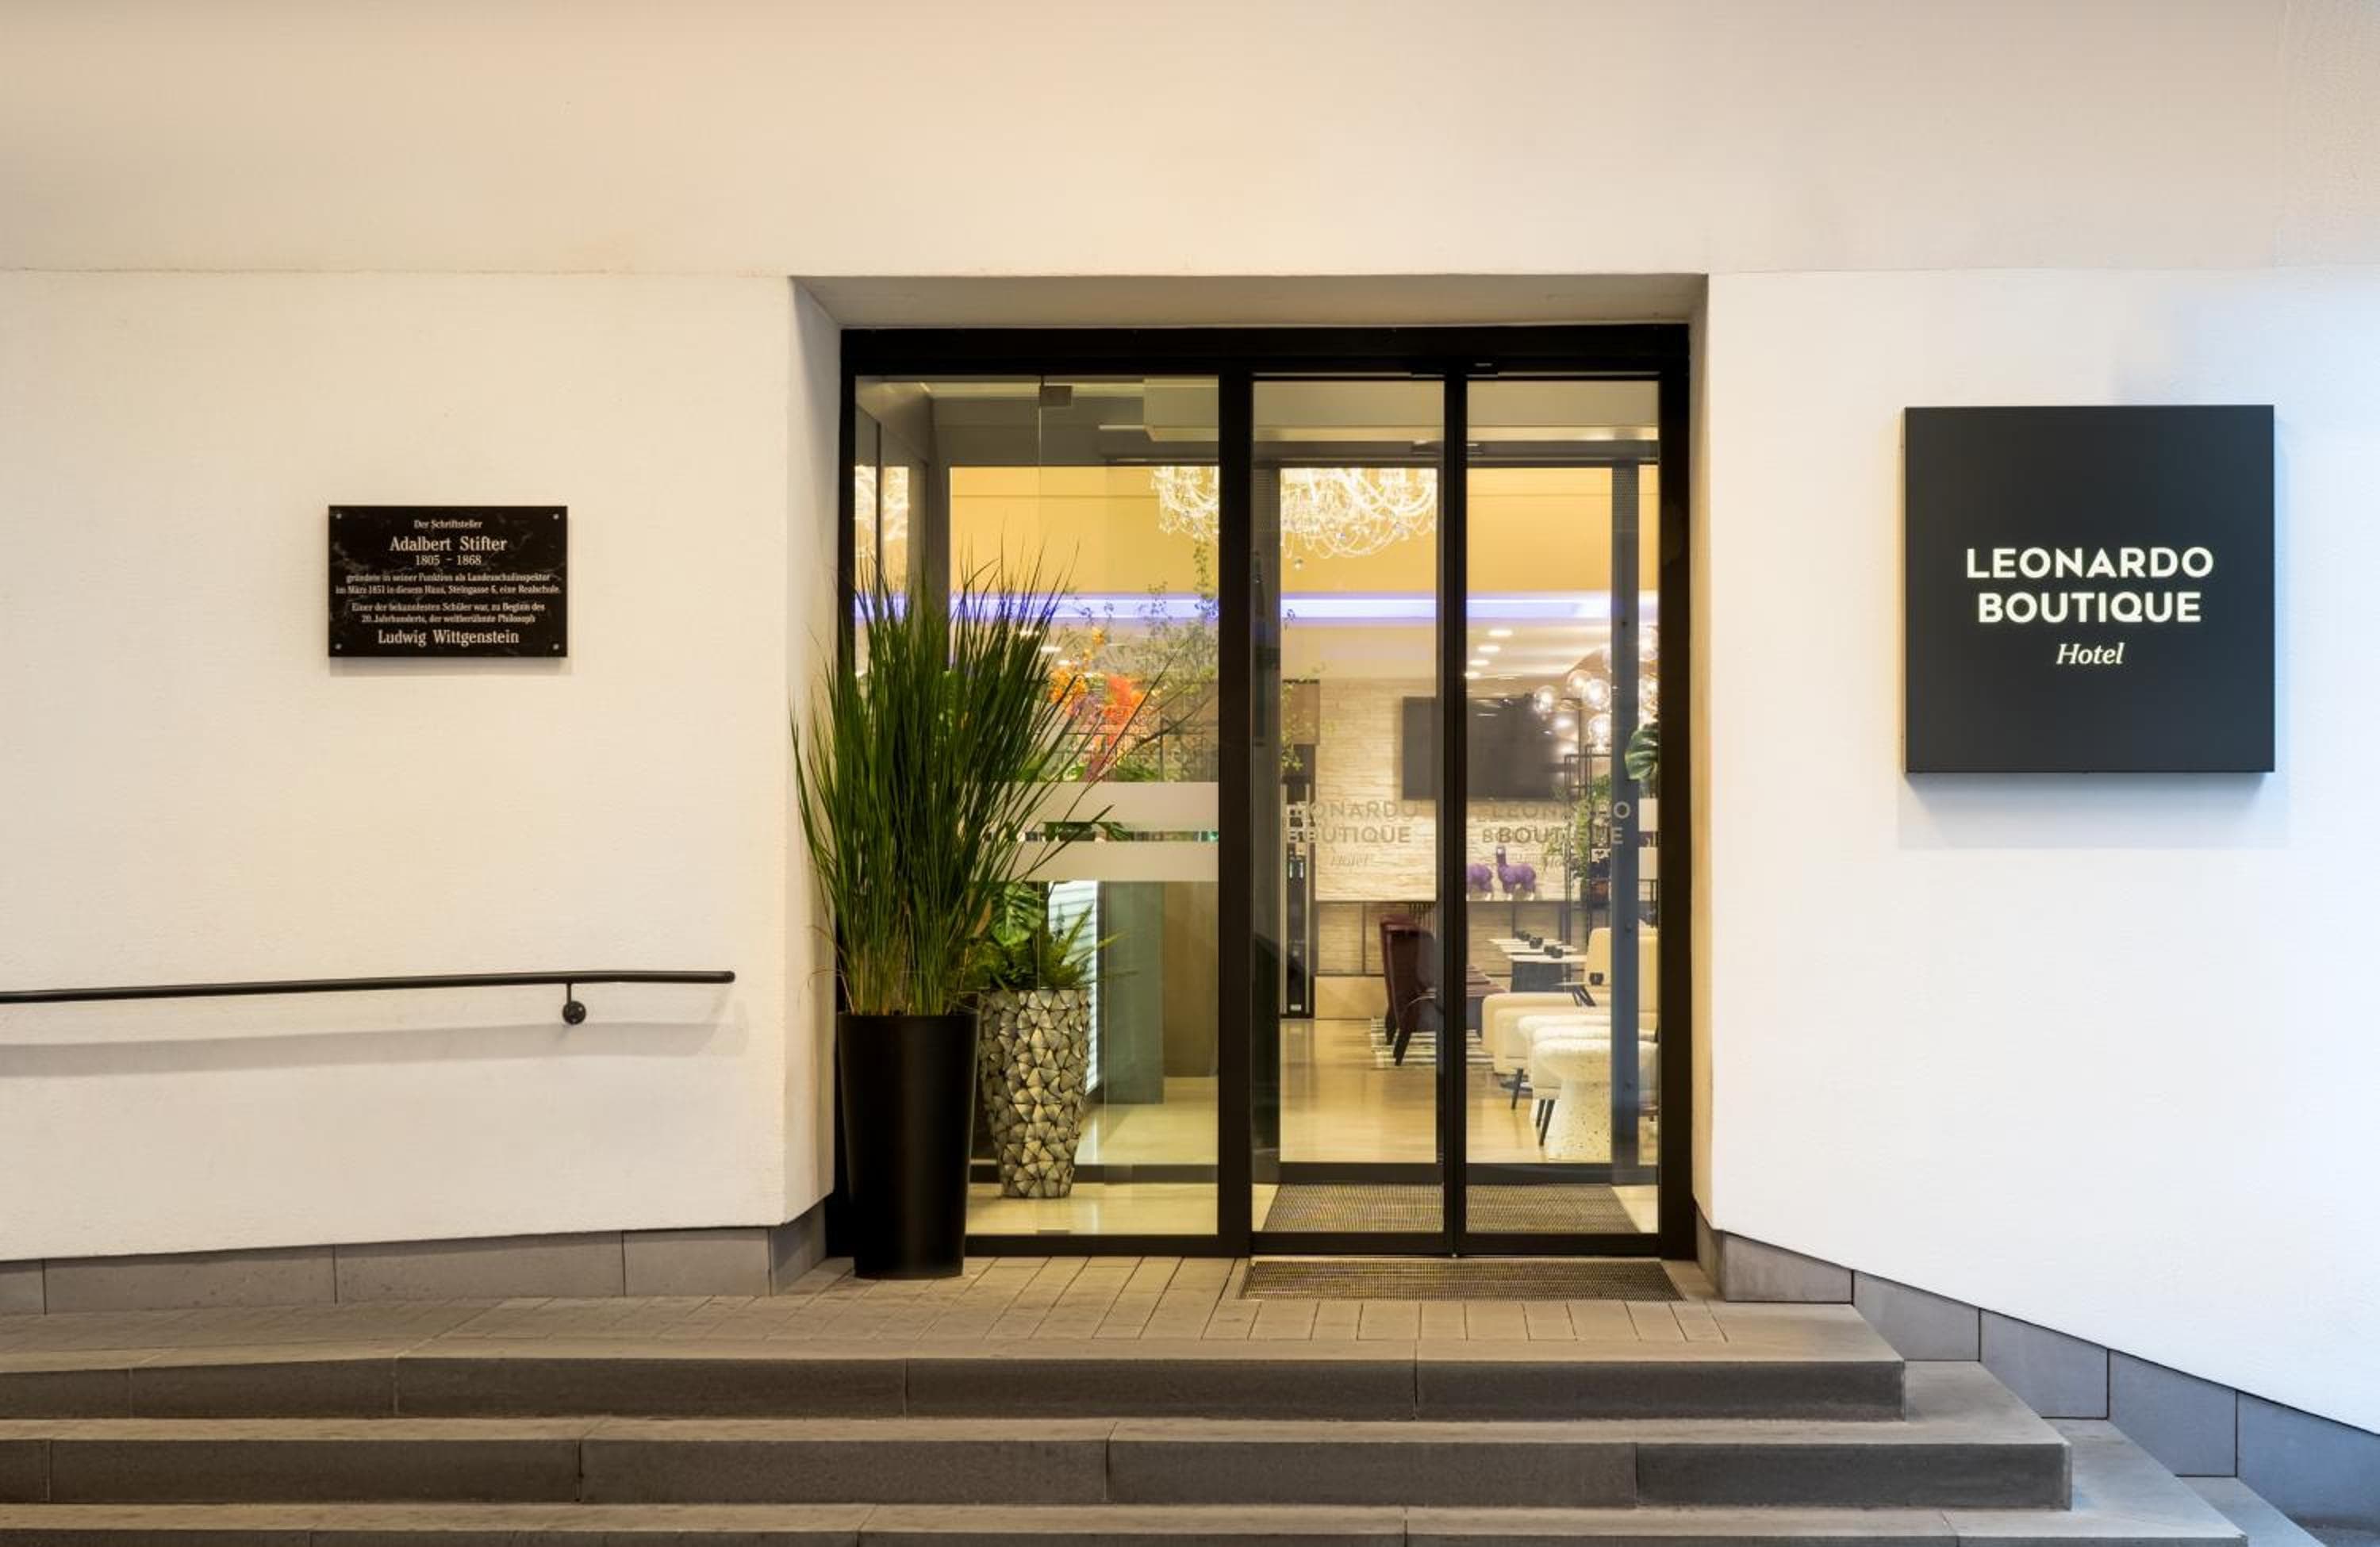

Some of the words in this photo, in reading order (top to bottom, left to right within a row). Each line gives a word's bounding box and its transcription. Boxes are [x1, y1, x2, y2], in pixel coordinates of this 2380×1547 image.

[414, 520, 429, 529] Der
[431, 520, 482, 529] Schriftsteller
[390, 536, 451, 551] Adalbert
[459, 536, 508, 551] Stifter
[415, 555, 440, 566] 1805
[456, 555, 482, 566] 1868
[1967, 547, 2213, 579] LEONARDO
[1979, 591, 2202, 624] BOUTIQUE
[378, 629, 426, 647] Ludwig
[432, 629, 520, 647] Wittgenstein
[2056, 642, 2125, 665] Hotel
